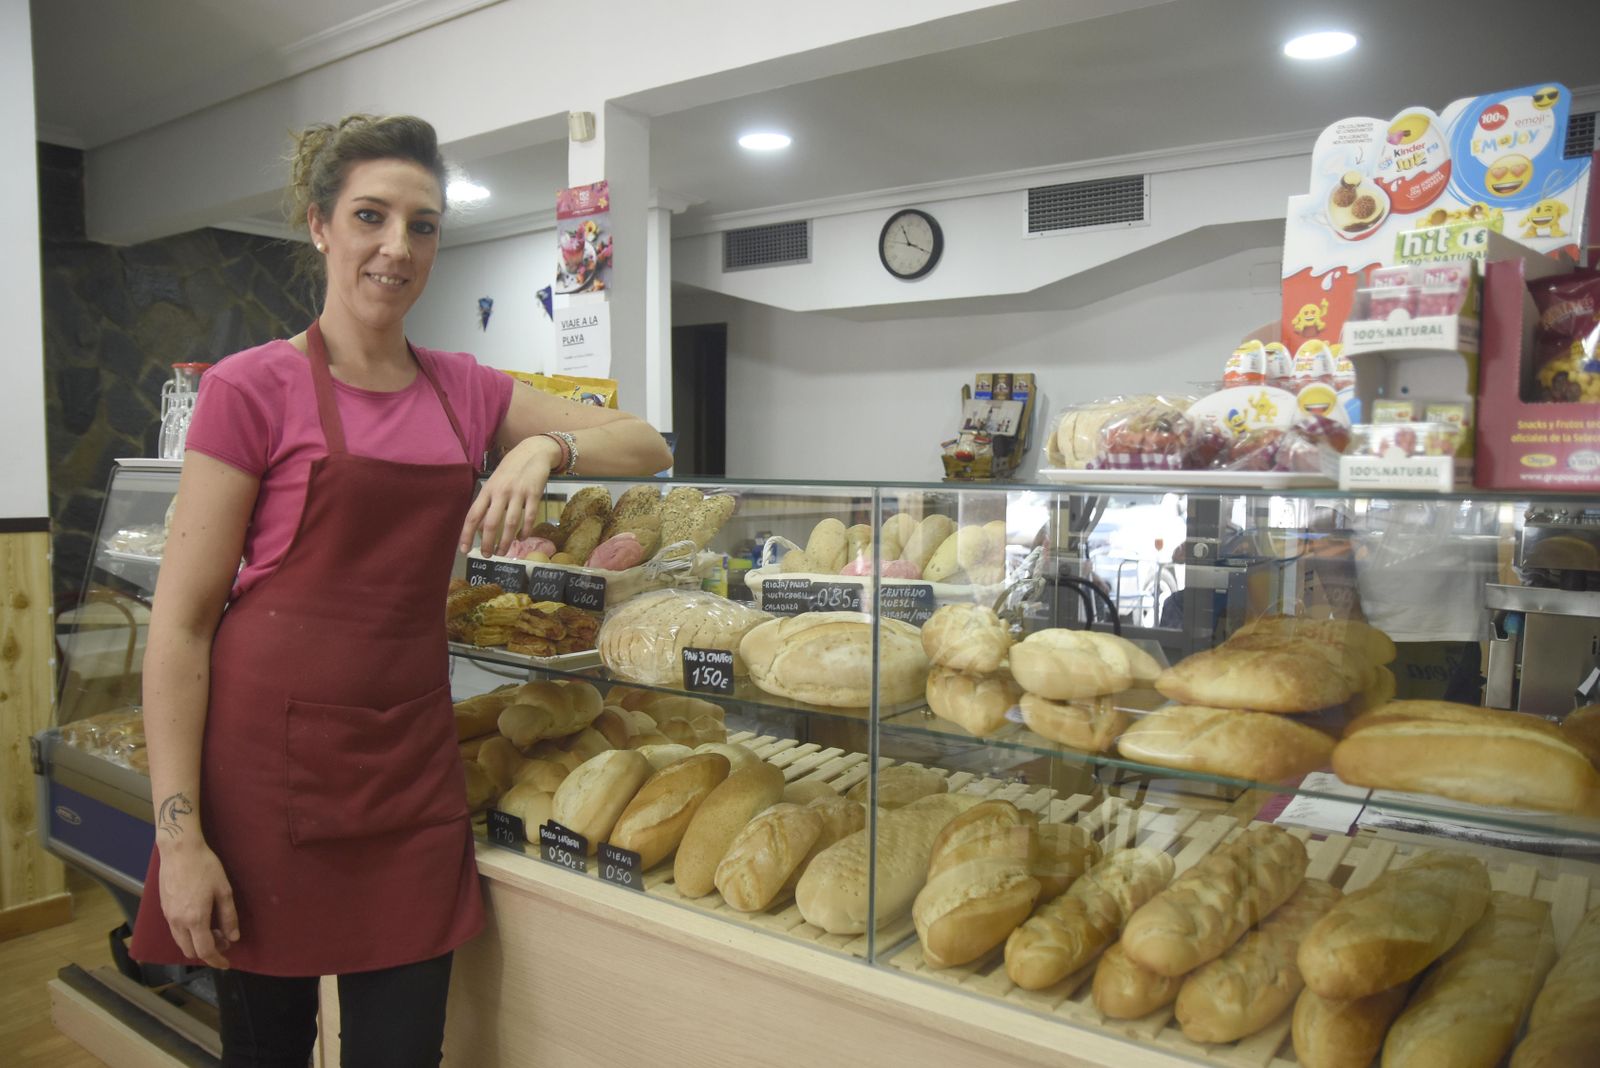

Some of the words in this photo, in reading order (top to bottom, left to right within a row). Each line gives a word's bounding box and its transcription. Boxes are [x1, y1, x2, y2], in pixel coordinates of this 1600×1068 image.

[1401, 227, 1450, 258] hit
[561, 318, 581, 329] VIAJE
[582, 318, 588, 326] A
[589, 315, 598, 325] LA
[562, 334, 584, 345] PLAYA
[1549, 433, 1561, 442] de
[1562, 433, 1571, 442] la
[683, 650, 698, 661] PAN
[699, 651, 705, 662] 3
[606, 850, 632, 867] VIENA
